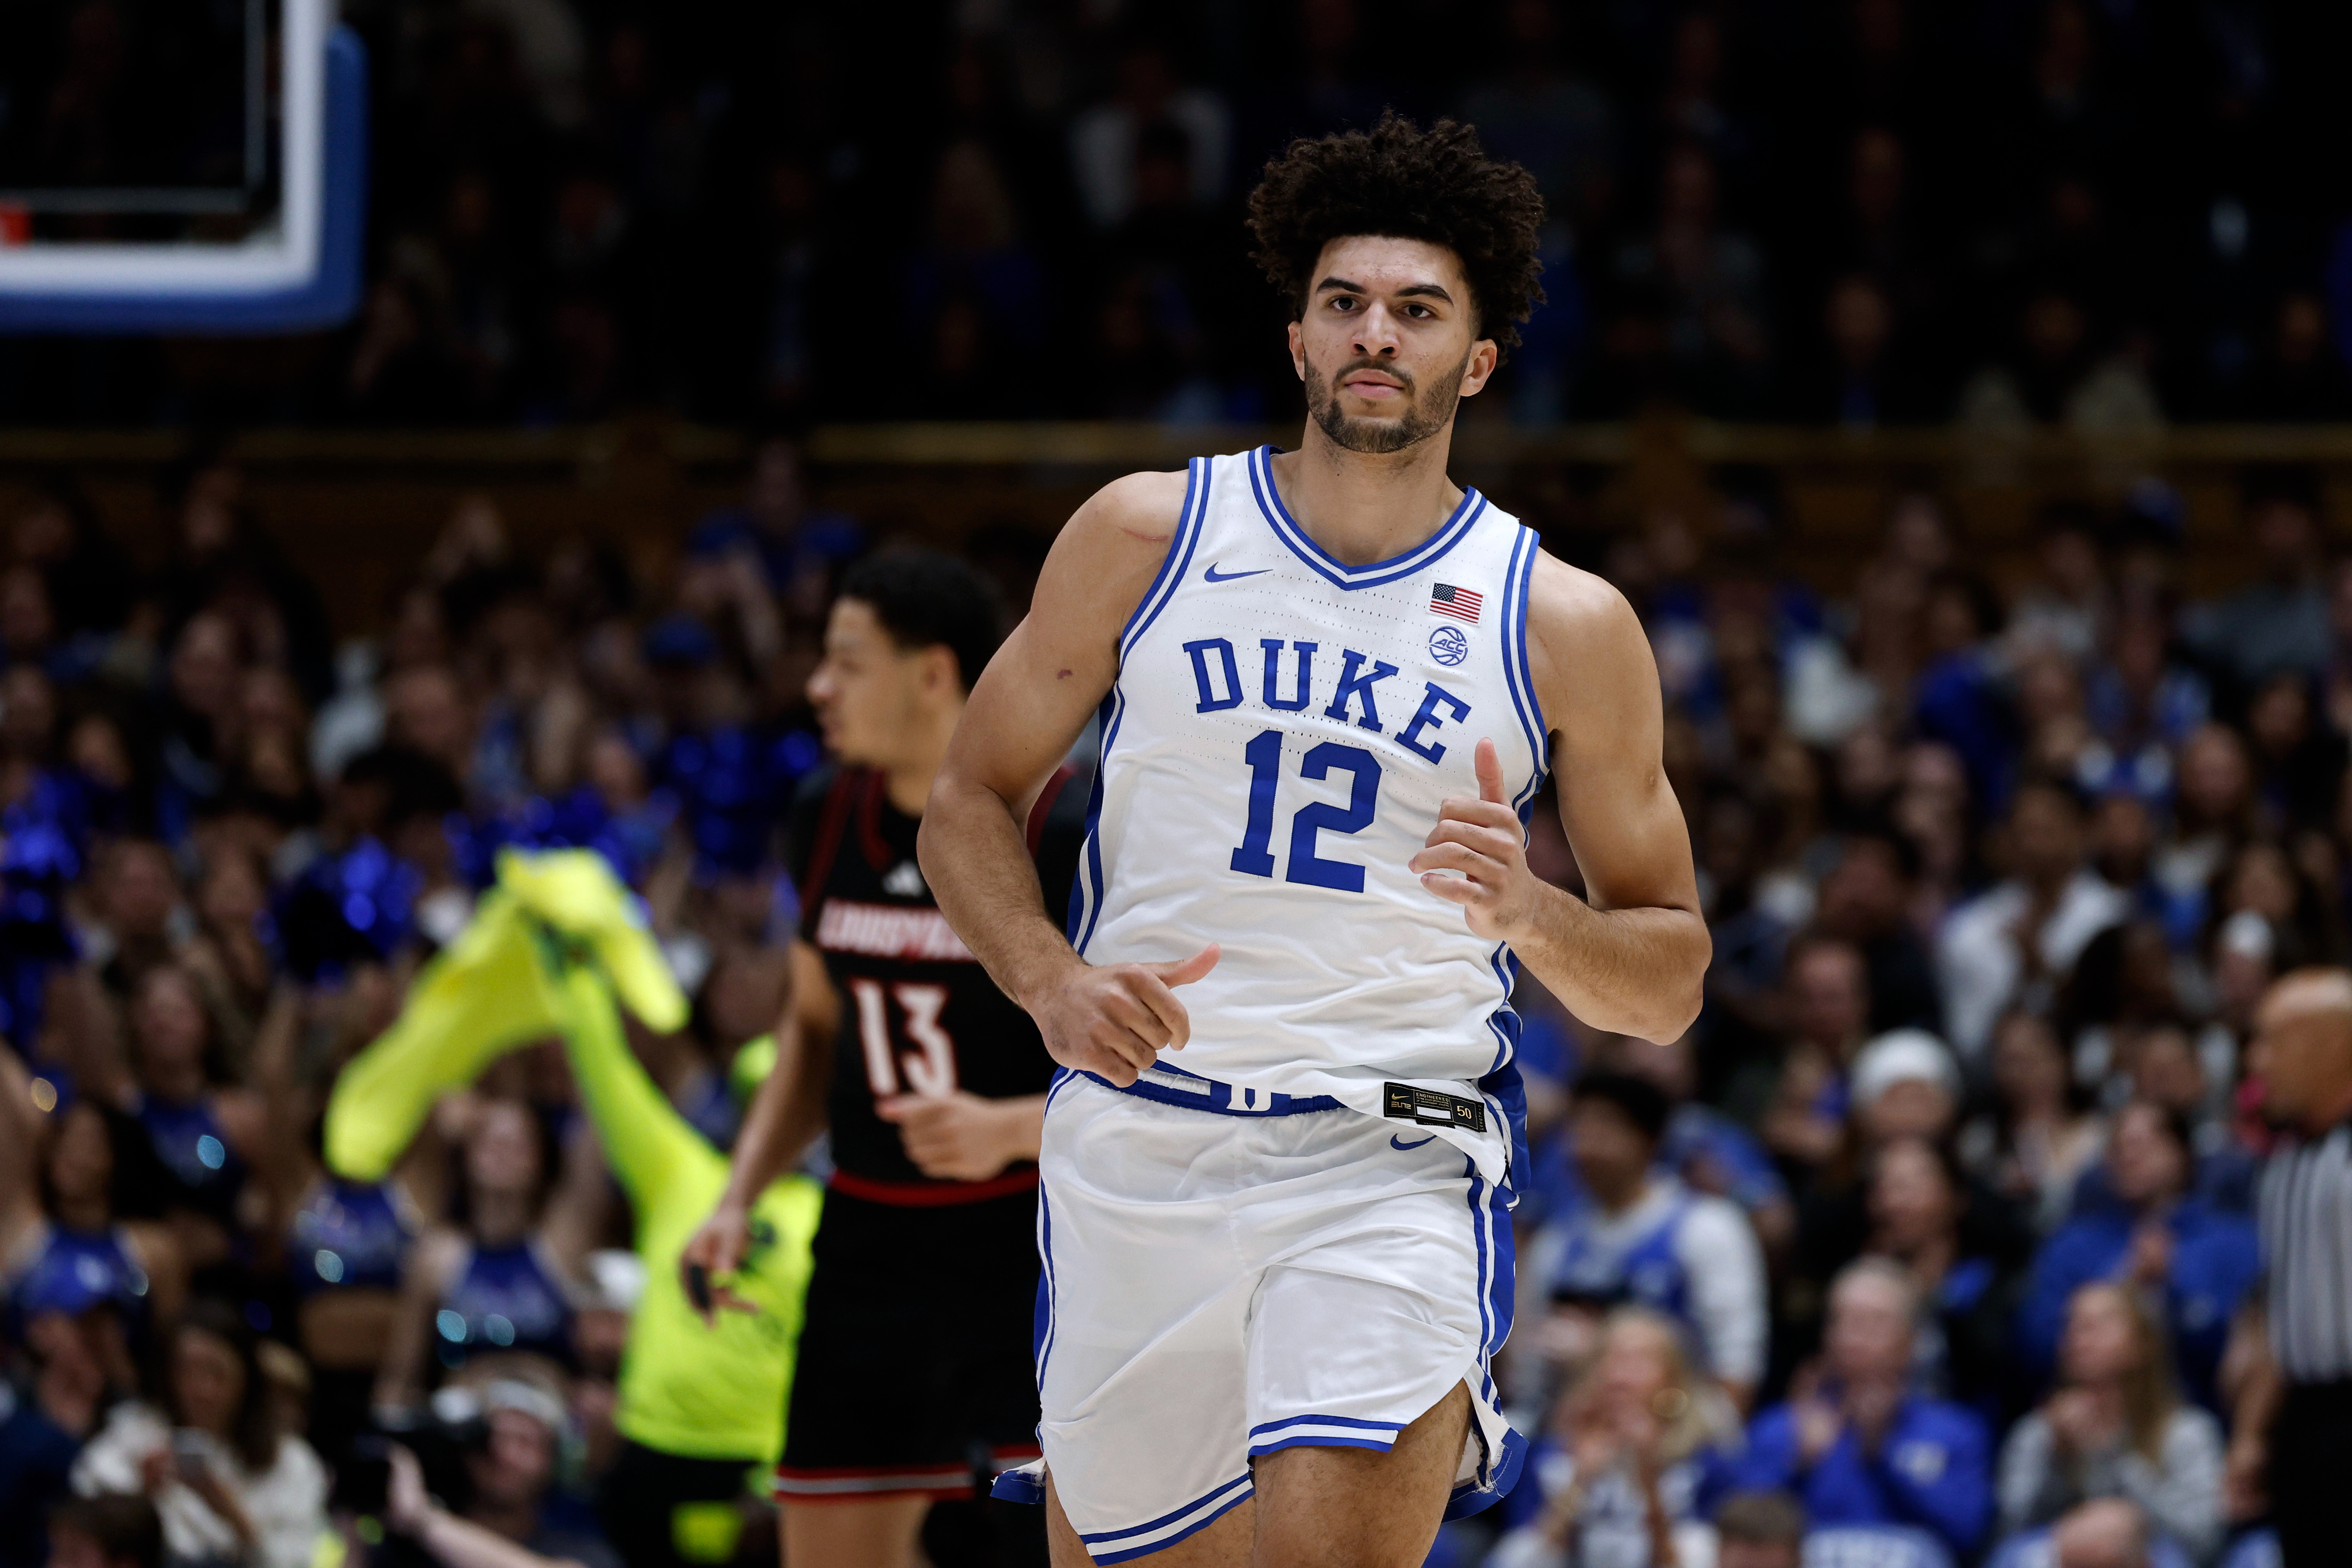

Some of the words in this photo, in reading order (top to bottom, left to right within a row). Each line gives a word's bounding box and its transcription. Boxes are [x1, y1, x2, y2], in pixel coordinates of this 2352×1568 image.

[1434, 638, 1467, 652] ACC
[1183, 638, 1471, 765] DUKE
[1230, 729, 1382, 893] 12
[850, 979, 958, 1098] 13
[1416, 1092, 1449, 1102] ENGINEERED
[1457, 1105, 1472, 1119] 50
